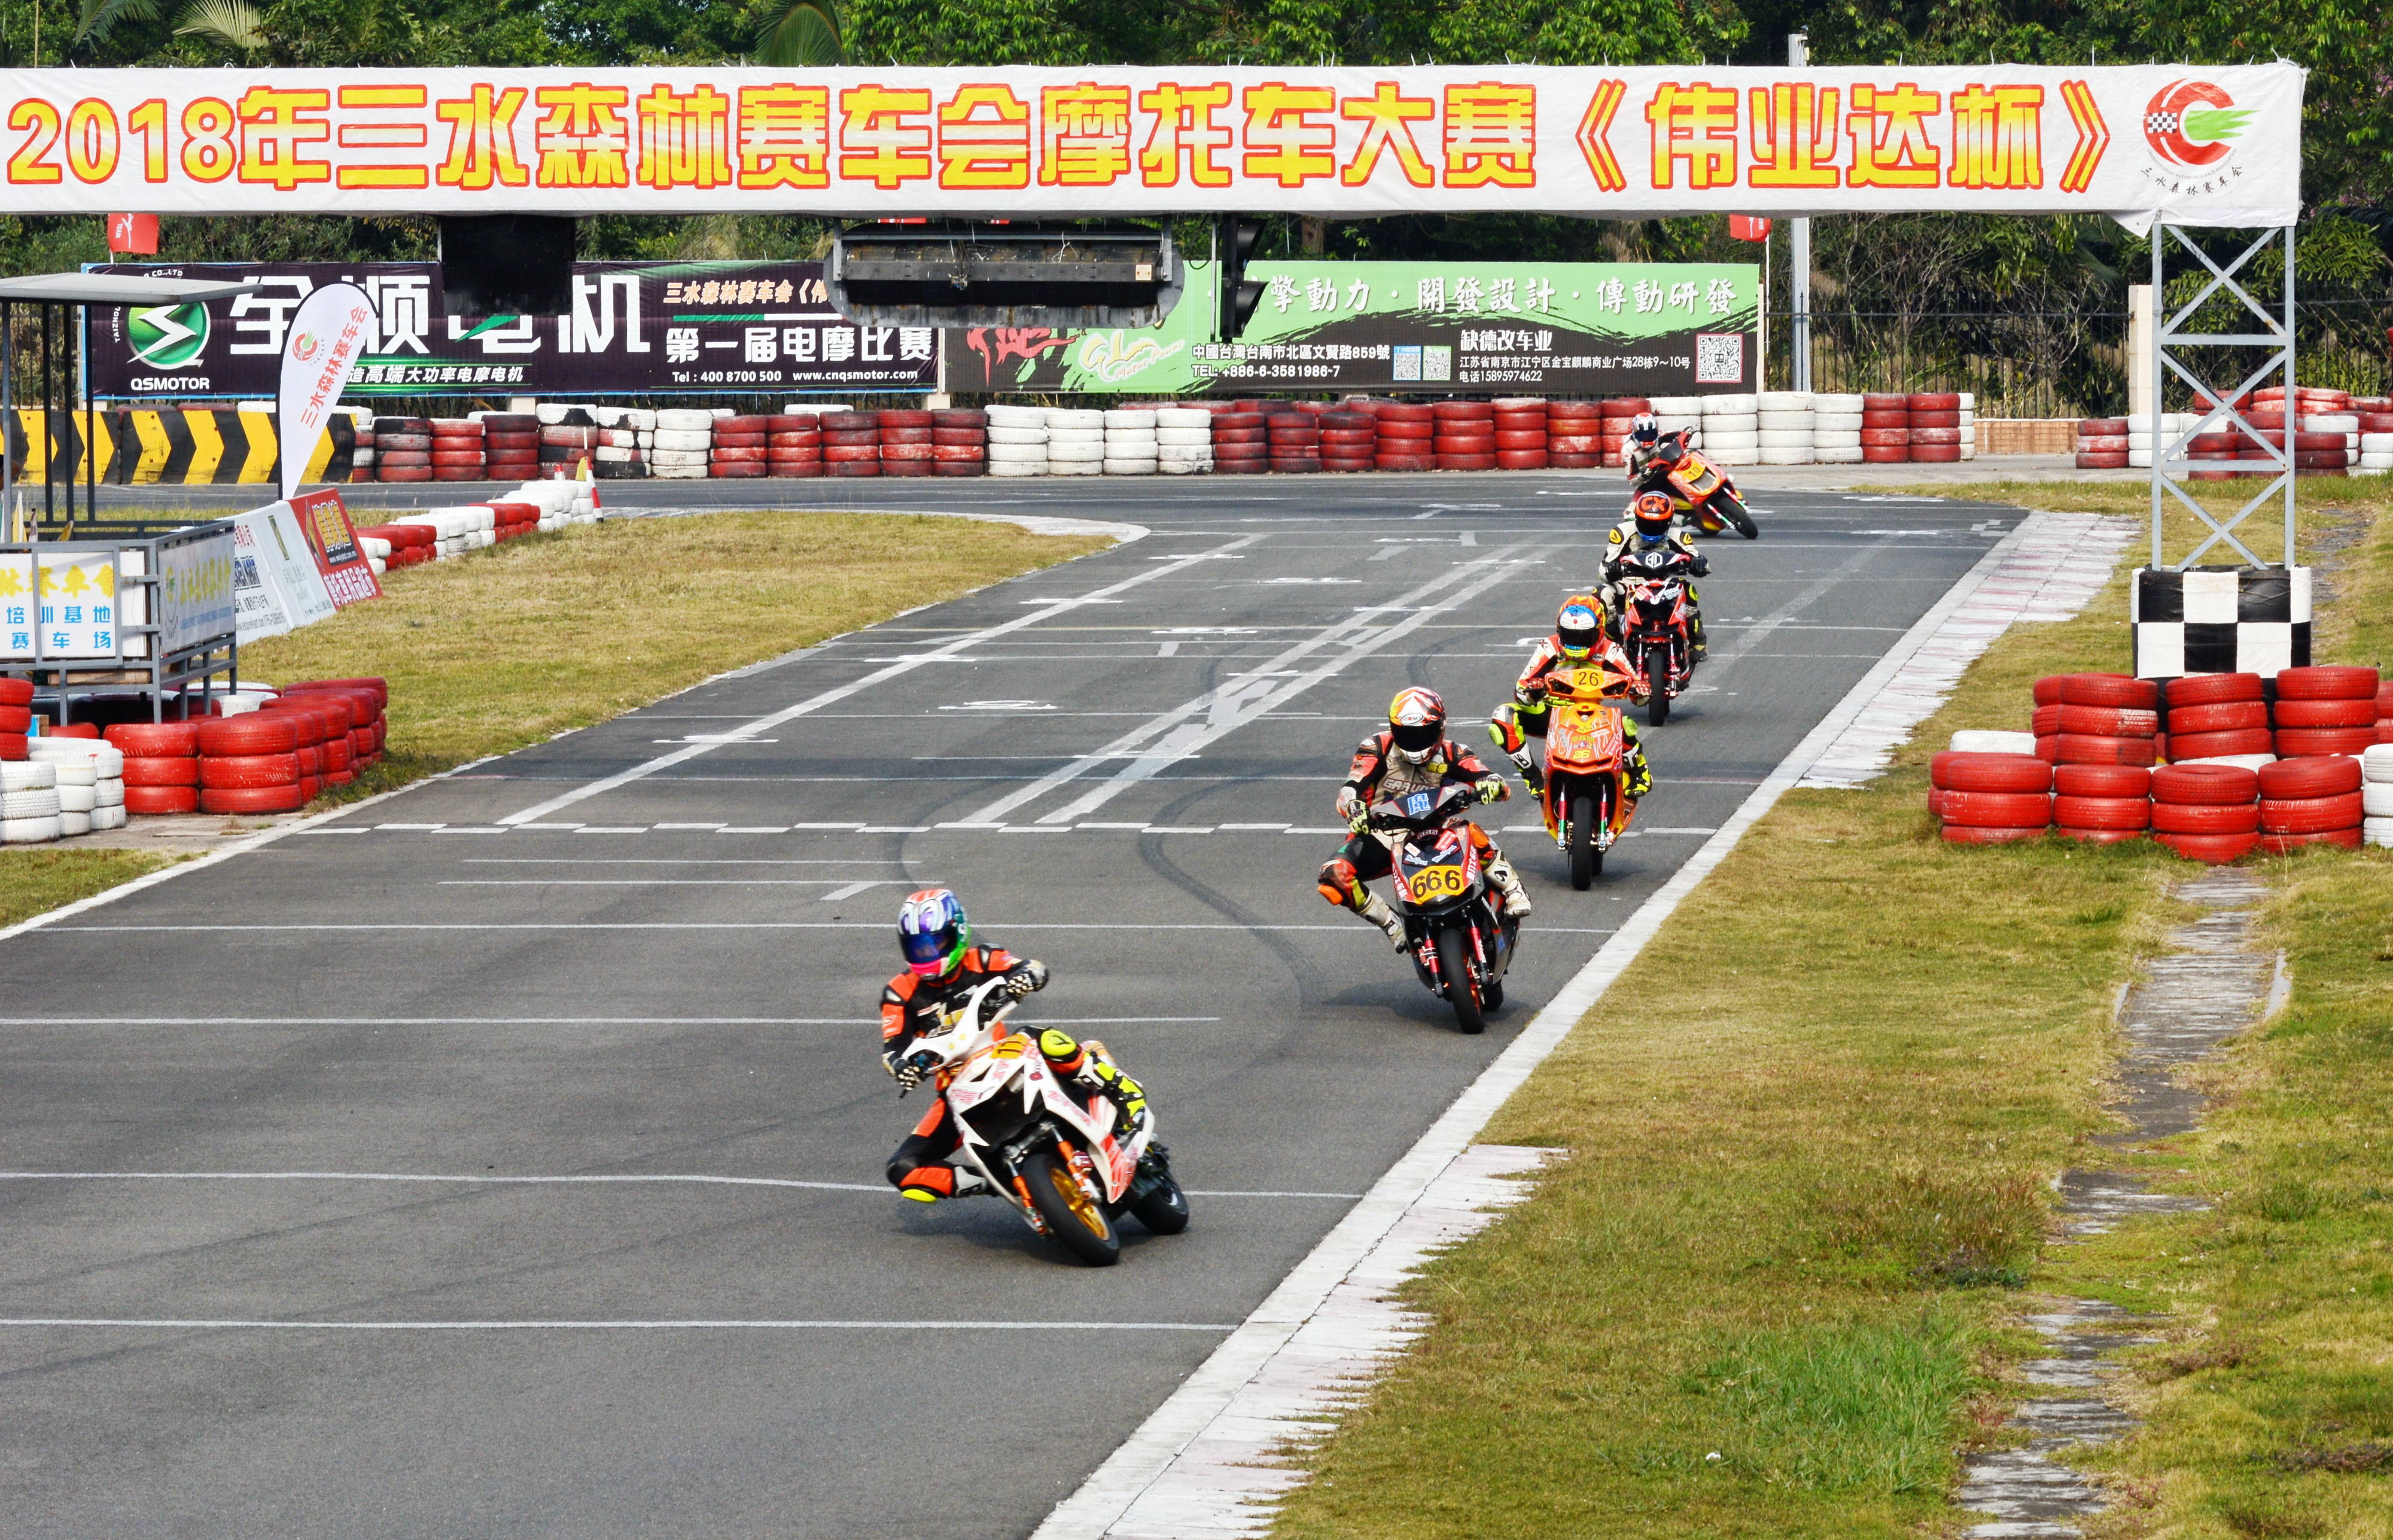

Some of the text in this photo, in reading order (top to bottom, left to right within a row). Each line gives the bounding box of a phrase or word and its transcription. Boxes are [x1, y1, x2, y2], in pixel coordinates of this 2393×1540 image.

[7, 78, 2110, 193] 2018年三水森林赛车会摩托车大赛《伟业达杯》
[666, 326, 932, 364] 第一届电摩比赛
[1460, 330, 1552, 352] 缺德改车业
[1192, 344, 1390, 360] 中國台灣台南市北區文賢路859號
[300, 305, 369, 429] 三水森林赛车会
[346, 365, 523, 384] 造高端大功率电摩电机
[1192, 365, 1340, 378] TEL: +886-6-3581986~7
[130, 378, 210, 391] QSMOTOR
[672, 372, 690, 383] Tel
[701, 372, 724, 383] 400
[726, 372, 757, 383] 8700
[759, 372, 782, 382] 500
[793, 370, 918, 382] www.cnqsmotor.com
[1460, 370, 1542, 383] 电话15895974622
[1642, 497, 1666, 512] CX
[1579, 671, 1599, 687] 26
[1573, 749, 1591, 760] 26
[1382, 778, 1438, 793] GARUD
[1412, 870, 1460, 899] 666
